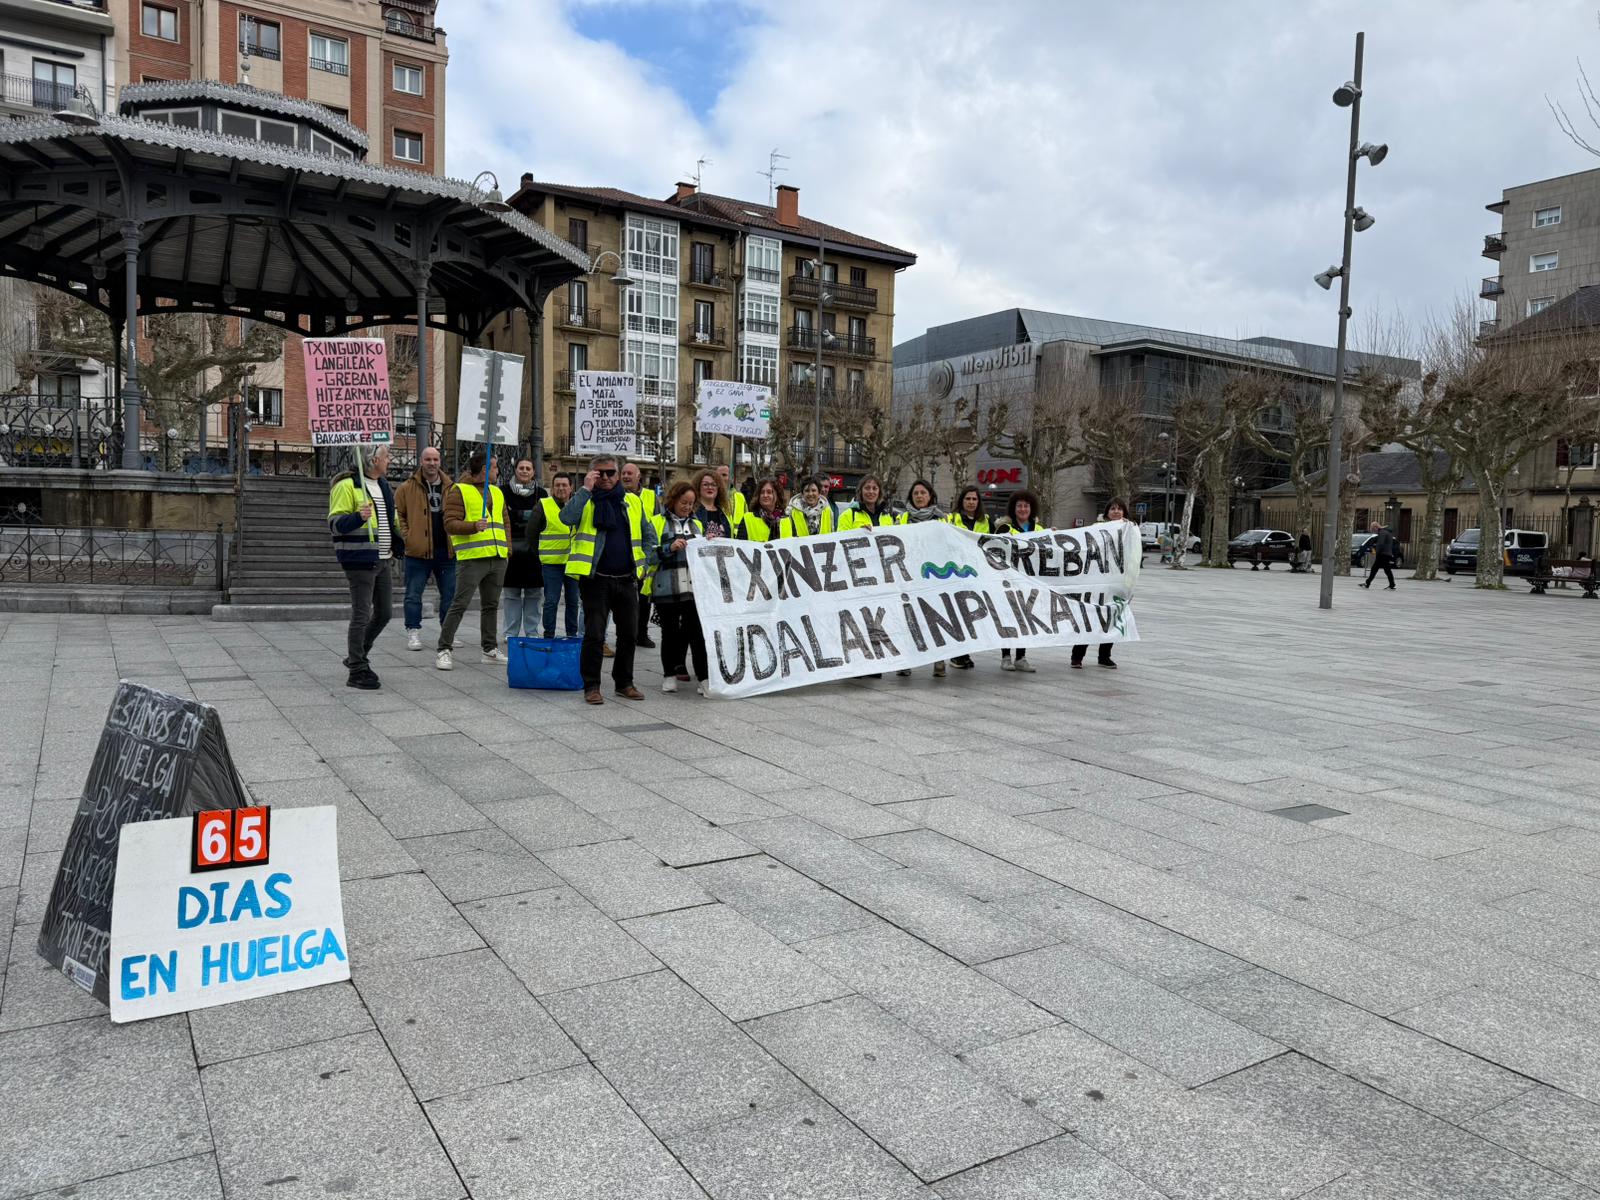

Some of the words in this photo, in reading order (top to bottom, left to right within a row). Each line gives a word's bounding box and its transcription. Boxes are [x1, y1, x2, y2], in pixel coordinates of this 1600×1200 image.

[304, 341, 383, 356] TXINGUDIKO
[961, 344, 1031, 375] Mendibil
[579, 375, 591, 387] EL
[316, 388, 389, 402] HITZARMENA
[592, 390, 615, 399] MATA
[367, 418, 391, 431] ESERI
[592, 409, 609, 418] POR
[360, 433, 372, 443] EZ
[614, 443, 627, 451] YA
[977, 528, 1125, 578] GREBAN
[714, 606, 900, 685] UDALAK
[110, 688, 176, 742] ESTAMOS
[177, 711, 204, 752] EN
[114, 736, 178, 797] HUELGA
[201, 816, 262, 862] 65
[177, 873, 292, 929] DIAS
[121, 951, 177, 1001] EN
[201, 927, 347, 986] HUELGA
